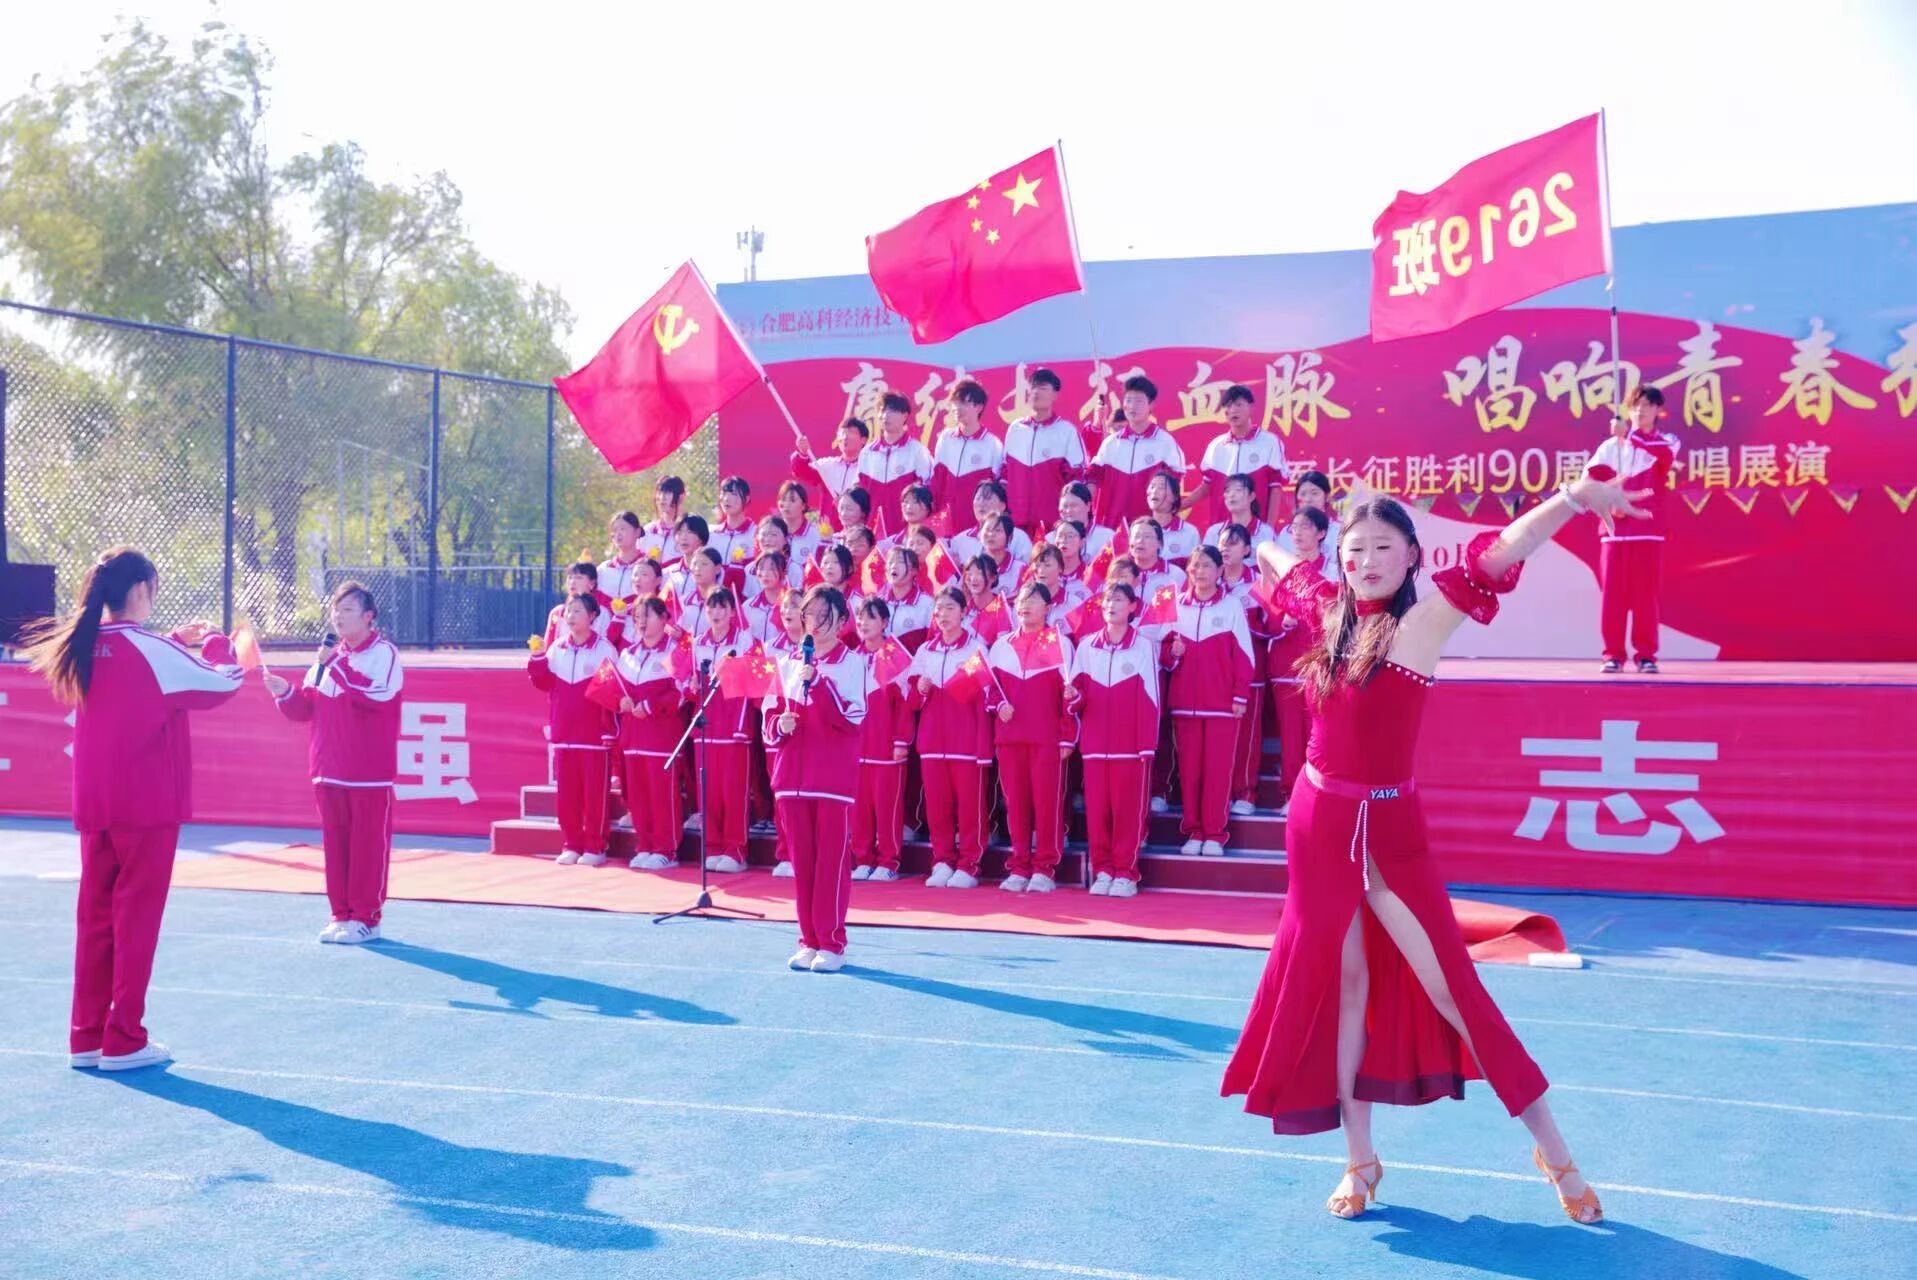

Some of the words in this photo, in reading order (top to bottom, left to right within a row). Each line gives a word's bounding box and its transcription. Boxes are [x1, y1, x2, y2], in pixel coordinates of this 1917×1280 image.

[761, 303, 908, 334] 合肥高科经济技
[1370, 788, 1399, 800] YAYA
[1513, 719, 1728, 856] 志
